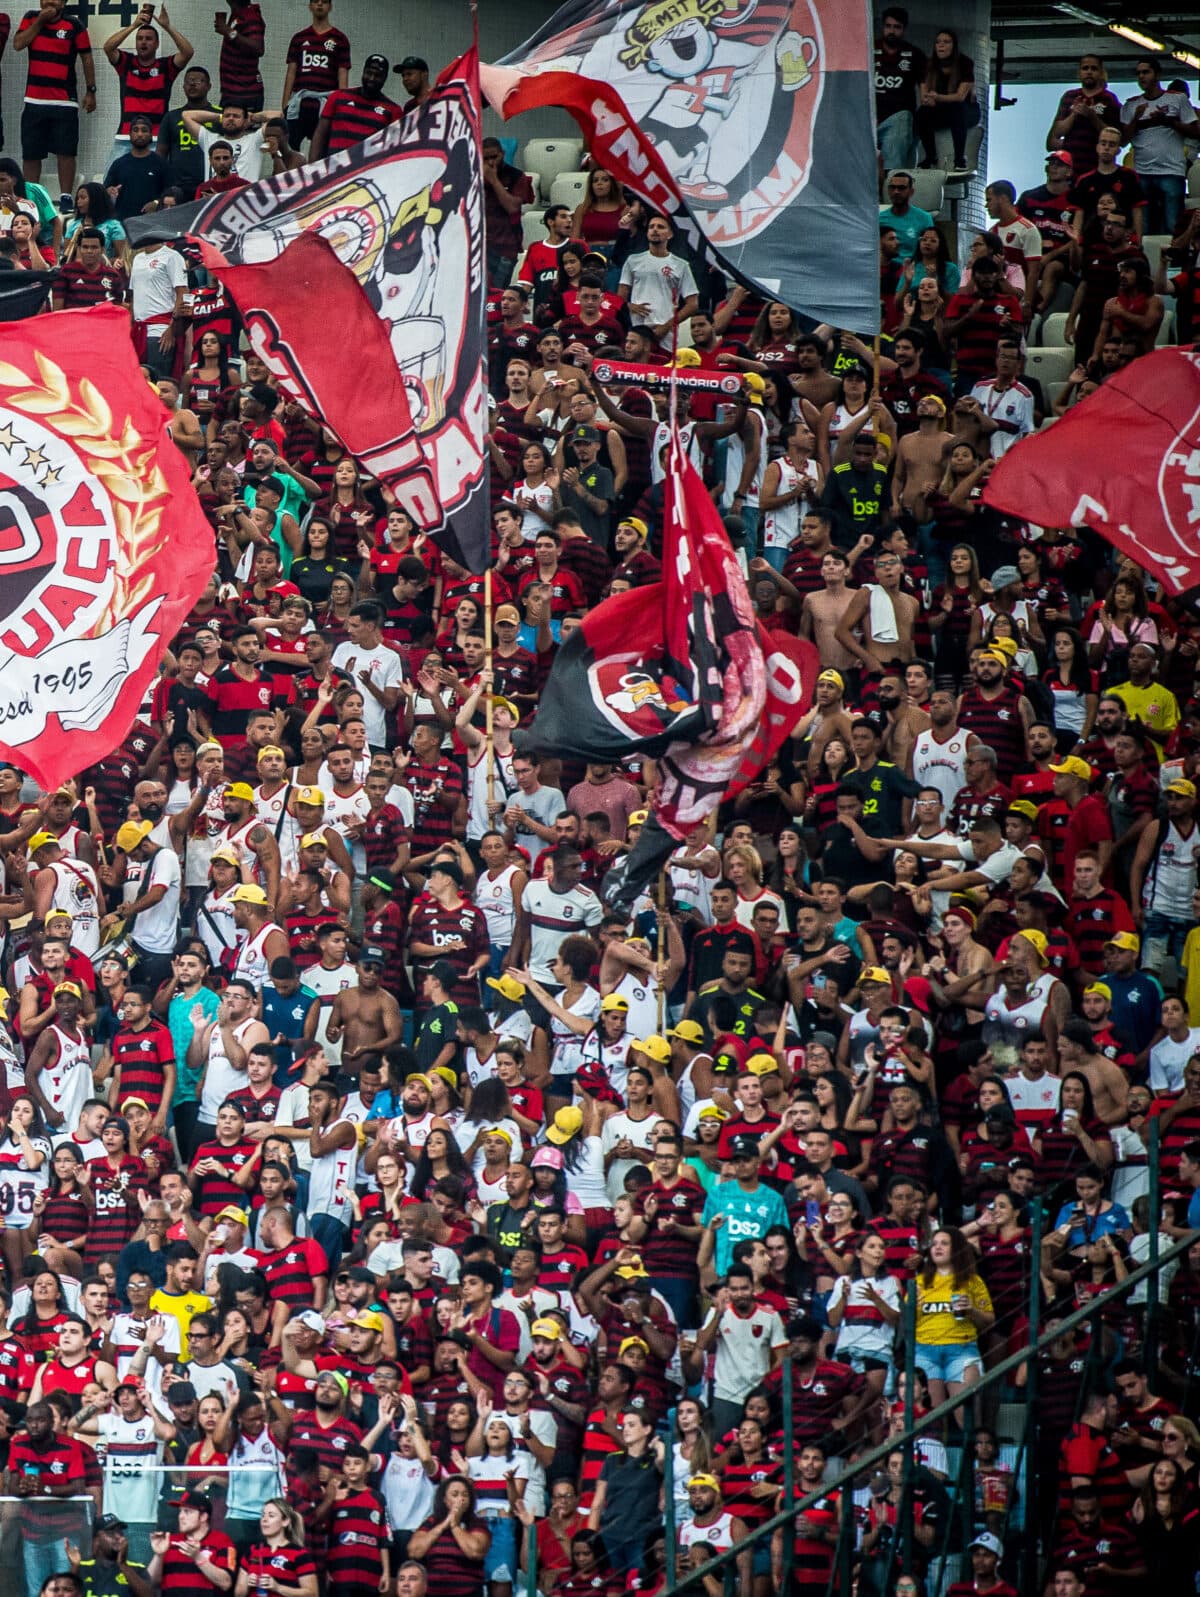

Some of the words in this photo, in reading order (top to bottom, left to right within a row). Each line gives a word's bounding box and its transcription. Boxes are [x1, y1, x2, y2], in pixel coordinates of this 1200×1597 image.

[302, 51, 329, 68] bs2
[875, 72, 903, 88] bs2
[540, 271, 558, 281] CAI
[616, 371, 644, 384] TFM
[661, 375, 719, 388] HONÓRIO
[32, 660, 94, 695] 1995
[0, 1181, 36, 1216] 95
[96, 1189, 126, 1208] bs2
[728, 1215, 760, 1238] bs2
[922, 1302, 952, 1314] CAIX
